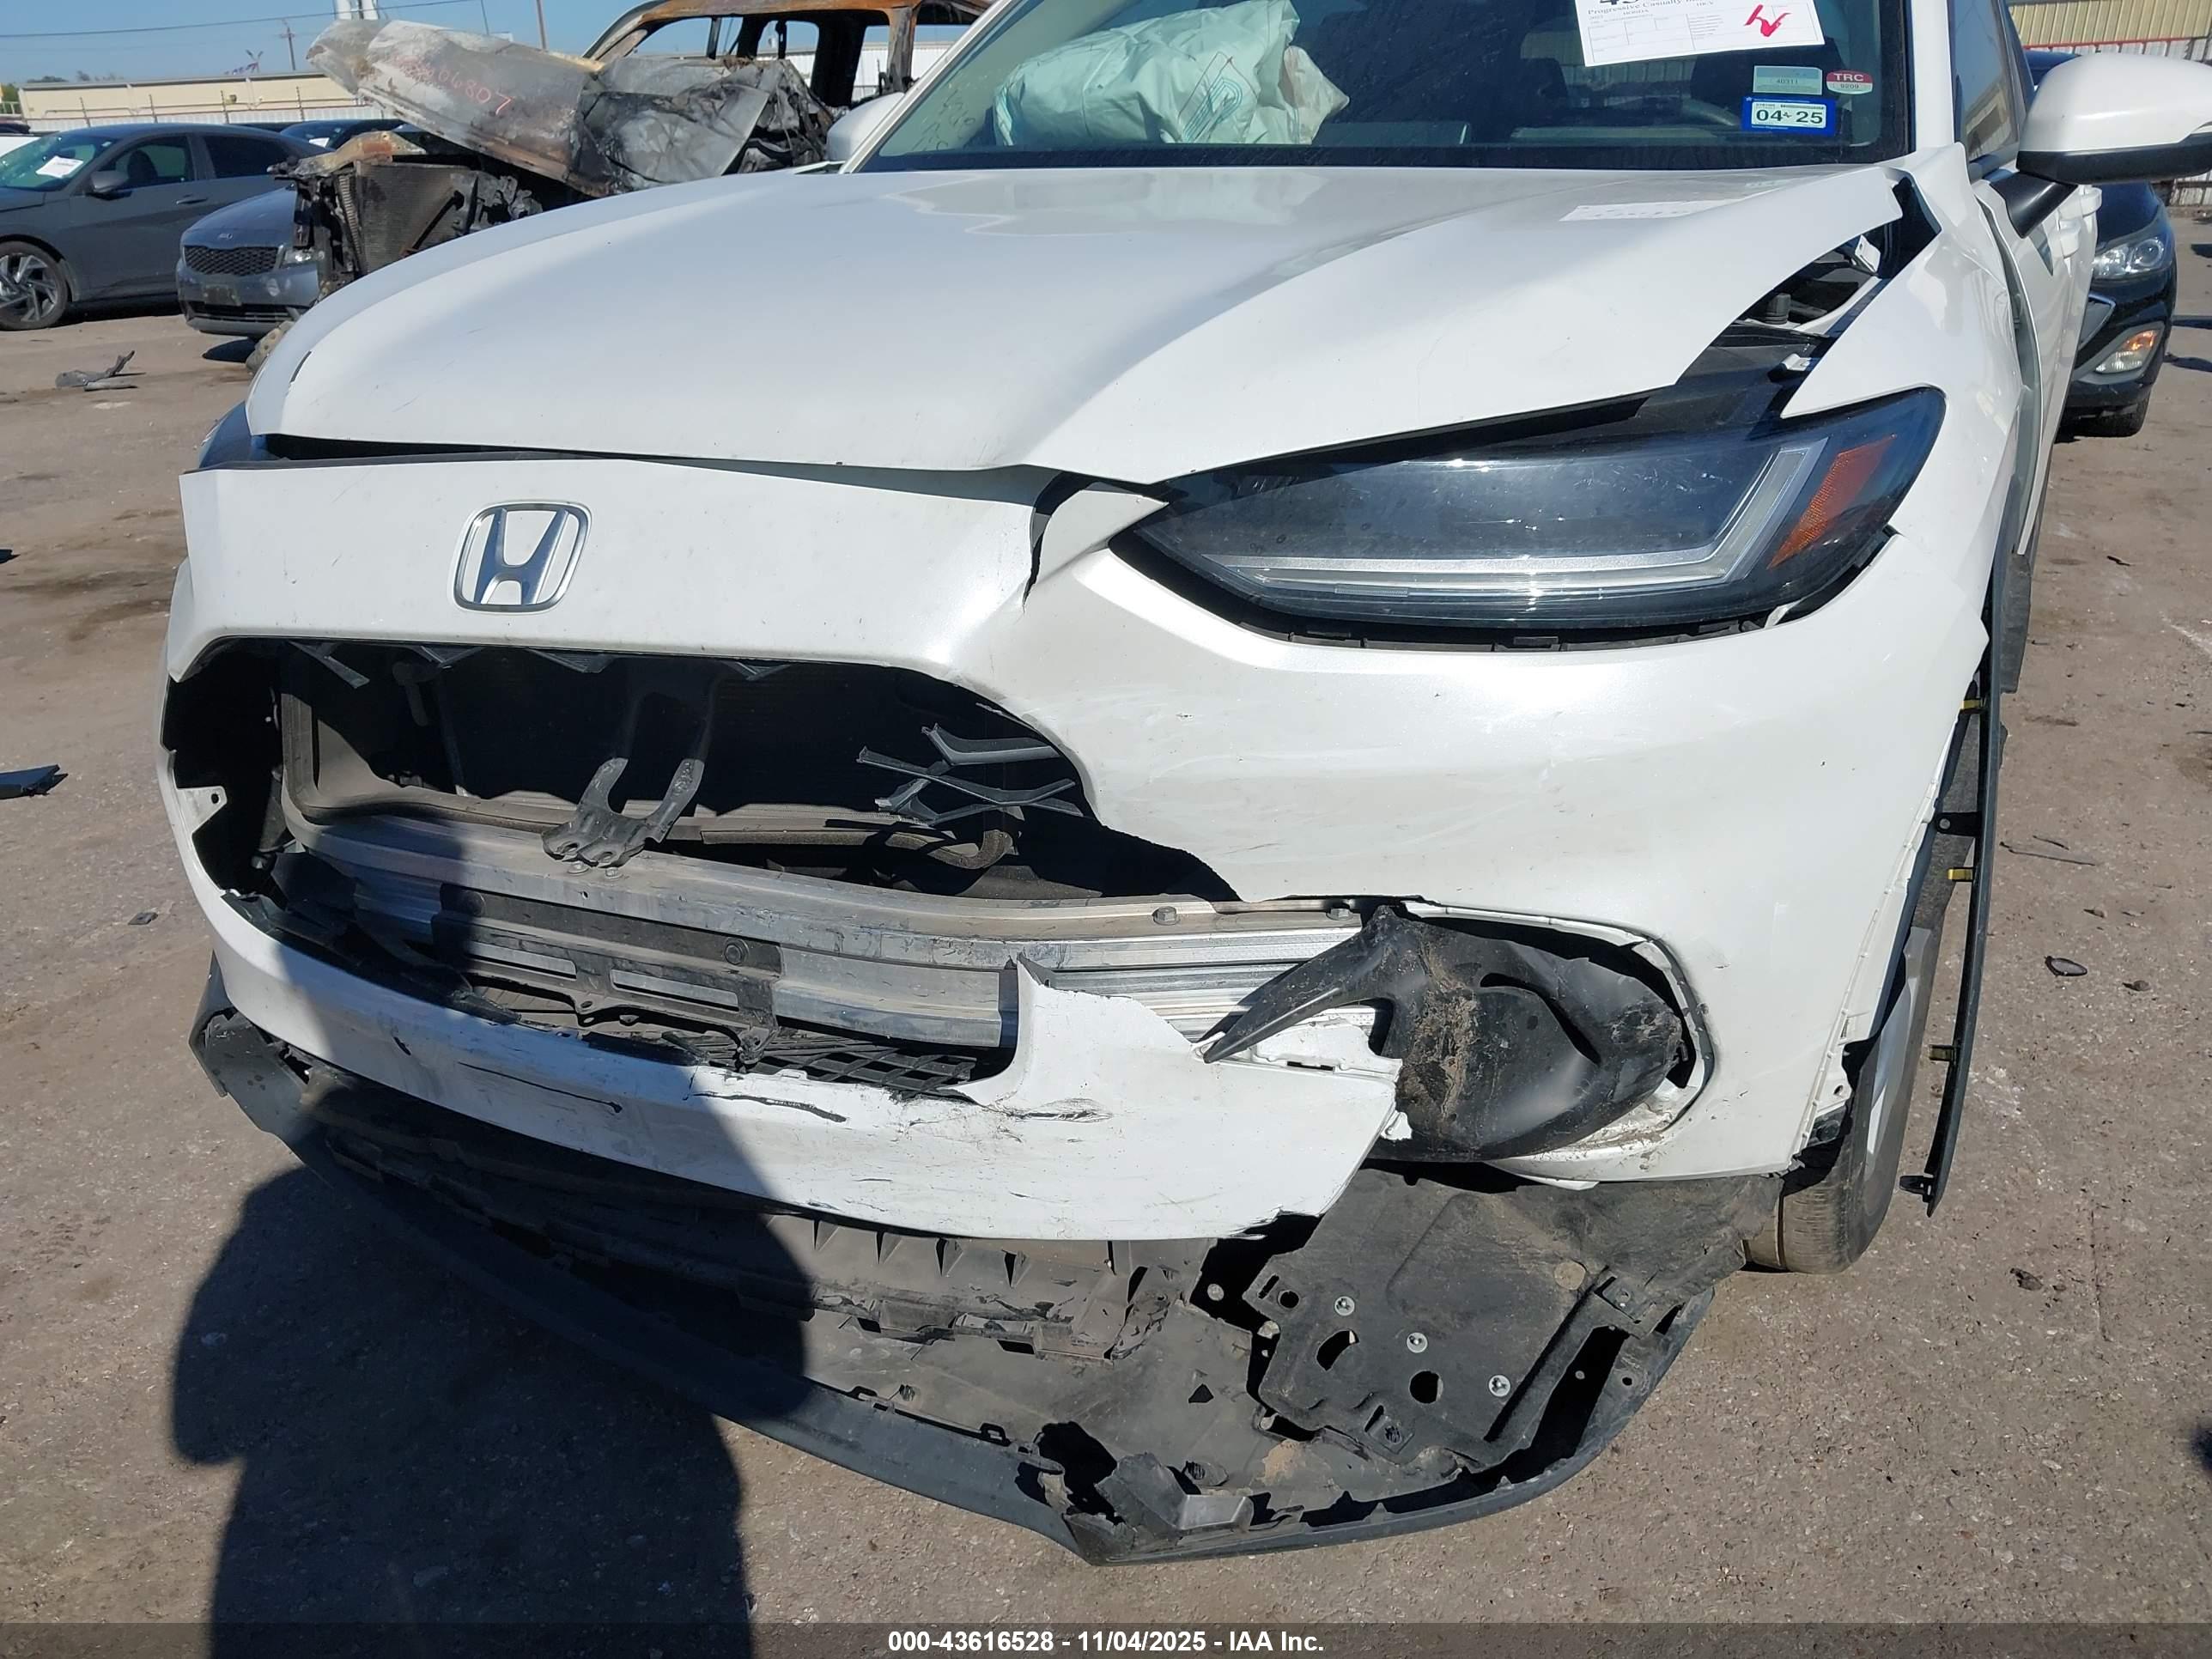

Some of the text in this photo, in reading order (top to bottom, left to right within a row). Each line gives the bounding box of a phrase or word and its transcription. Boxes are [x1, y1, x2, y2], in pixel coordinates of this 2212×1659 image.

[1588, 3, 1641, 15] Progressive
[1833, 73, 1864, 82] TRC
[1756, 109, 1823, 124] 04 25
